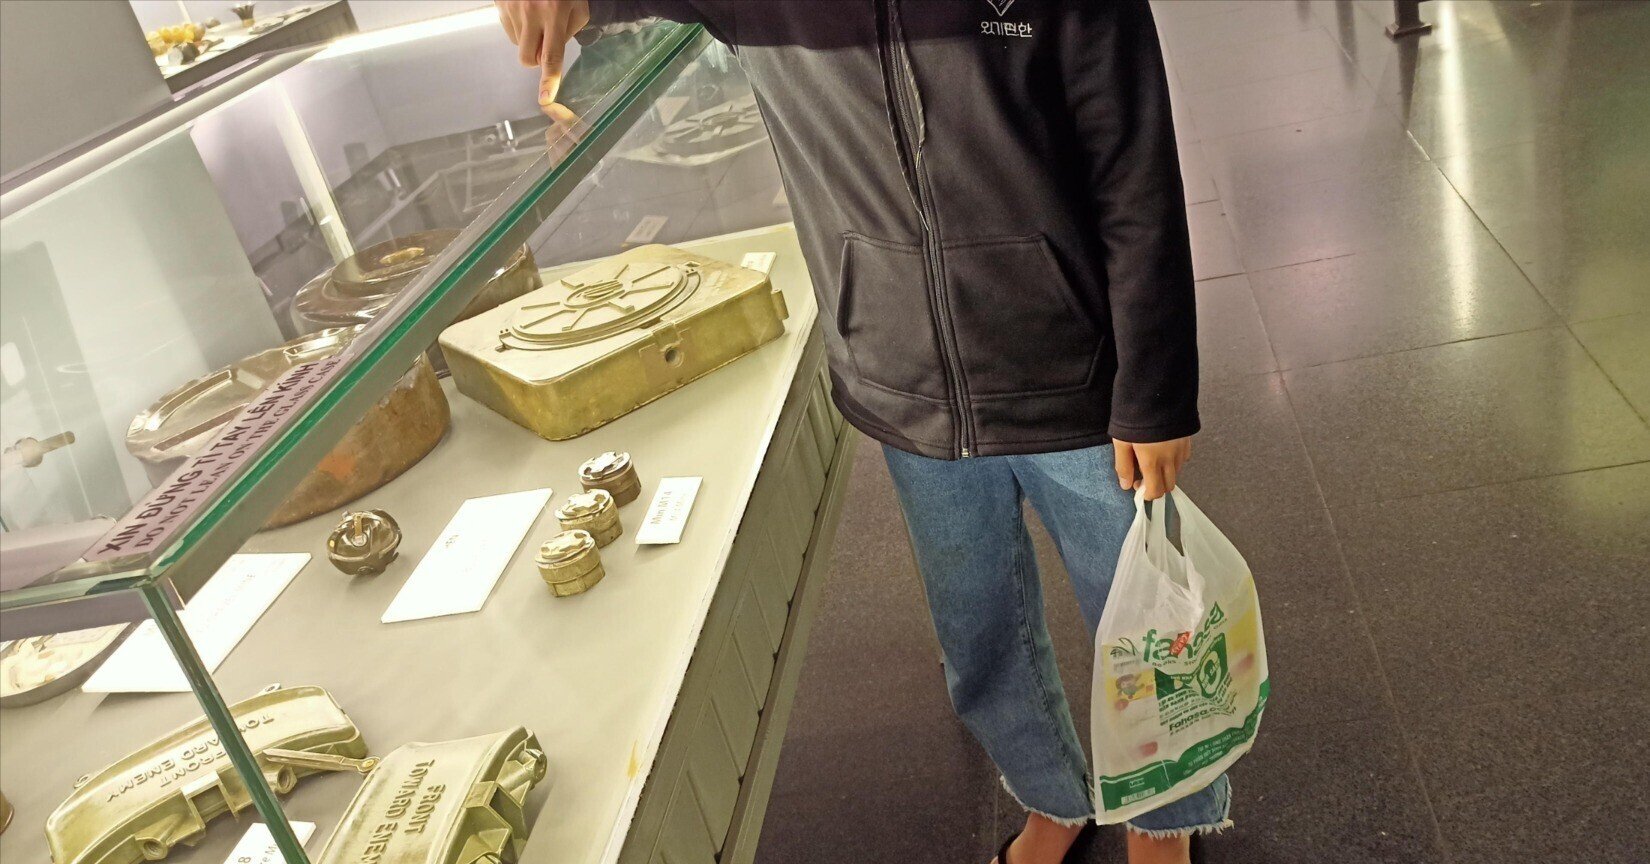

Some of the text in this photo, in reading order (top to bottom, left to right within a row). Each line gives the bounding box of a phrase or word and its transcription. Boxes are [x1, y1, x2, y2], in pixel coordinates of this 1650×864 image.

[97, 523, 148, 555] XIN
[135, 470, 203, 519] ĐỪNG
[209, 426, 251, 454] TAY
[241, 395, 284, 422] LÊN
[273, 362, 319, 393] KÍNH
[134, 358, 341, 547] DO NOT LEAN ON THE GLASS CASE
[107, 758, 176, 802] ENEMY
[160, 751, 227, 788] FRONT
[361, 759, 435, 864] TOWARD ENEM
[404, 784, 446, 834] FRONT
